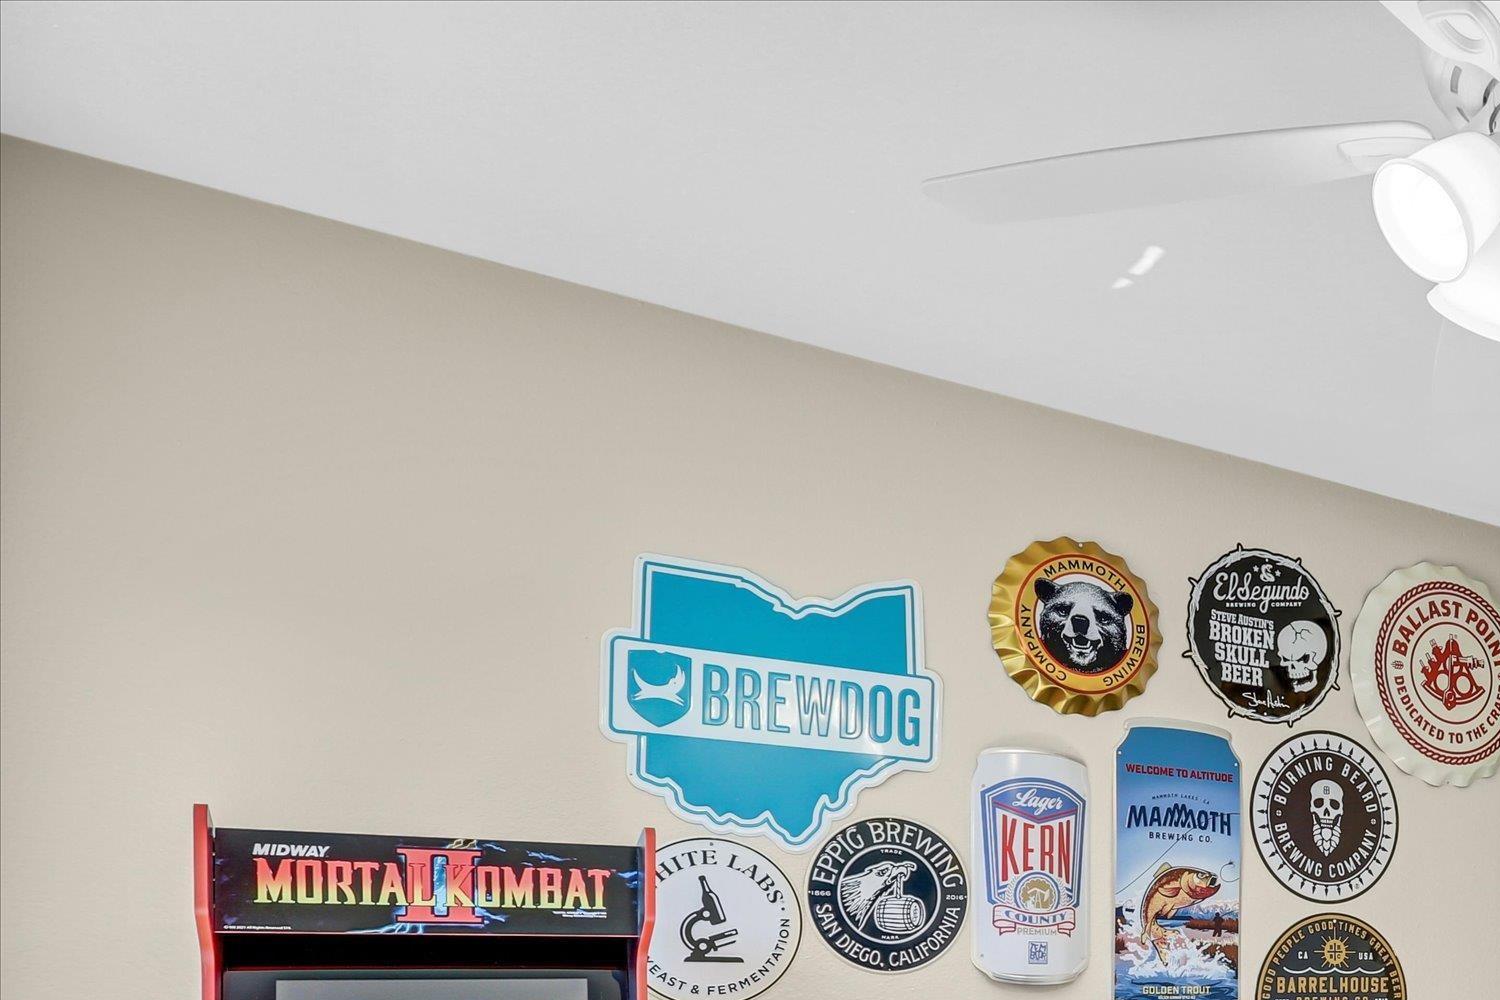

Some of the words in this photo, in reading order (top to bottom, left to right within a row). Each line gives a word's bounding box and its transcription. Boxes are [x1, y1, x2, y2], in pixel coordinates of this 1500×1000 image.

[1043, 559, 1126, 591] MAMMOTH
[1213, 572, 1239, 601] El
[1236, 570, 1310, 613] Segundo
[1209, 619, 1275, 650] BROKEN
[1210, 608, 1238, 623] STEVE
[1238, 614, 1275, 631] AUSTIN'S
[1391, 600, 1462, 657] BALLAST
[1021, 603, 1067, 682] COMPANY
[1103, 624, 1146, 687] BREWING
[1214, 641, 1270, 668] SKULL
[1221, 662, 1263, 687] BEER
[701, 663, 921, 746] BREWDOG
[1393, 675, 1445, 741] DEDICATED
[1448, 732, 1464, 745] TO
[1465, 720, 1488, 743] THE
[1125, 763, 1175, 777] WELCOME
[1177, 768, 1189, 778] TO
[1190, 771, 1234, 783] ALTITUDE
[1273, 755, 1333, 806] BURNING
[1341, 761, 1378, 814] BEARD
[1012, 788, 1063, 816] Lager
[1127, 802, 1232, 836] MAMMOTH
[252, 843, 330, 858] MIDWAY
[812, 826, 865, 885] EPPIG
[868, 821, 964, 888] BREWING
[1001, 814, 1071, 884] KERN
[1149, 831, 1193, 842] BREWING
[1199, 835, 1213, 843] CO.
[1274, 822, 1323, 878] BREWING
[1328, 829, 1377, 878] COMPANY
[253, 857, 436, 907] MORTAL
[444, 861, 611, 910] KOMBAT
[655, 849, 718, 884] HITE
[726, 853, 784, 905] LABS
[815, 903, 842, 938] SAN
[888, 905, 961, 966] CALIFORNIA
[1004, 909, 1067, 924] COUNTY
[1017, 926, 1057, 936] PREMIUM
[690, 984, 701, 996] &
[707, 917, 791, 995] FERMENTATION
[1262, 969, 1277, 1000] GOOD
[1273, 929, 1306, 965] PEOPLE
[1308, 920, 1334, 934] GOOD
[1339, 921, 1368, 940] TIMES
[1369, 938, 1393, 967] GREAT
[1389, 970, 1402, 999] BEER
[1298, 951, 1309, 960] CA
[1358, 952, 1374, 960] USA
[1142, 985, 1179, 995] GOLDEN
[1276, 976, 1389, 993] BARRELHOUSE
